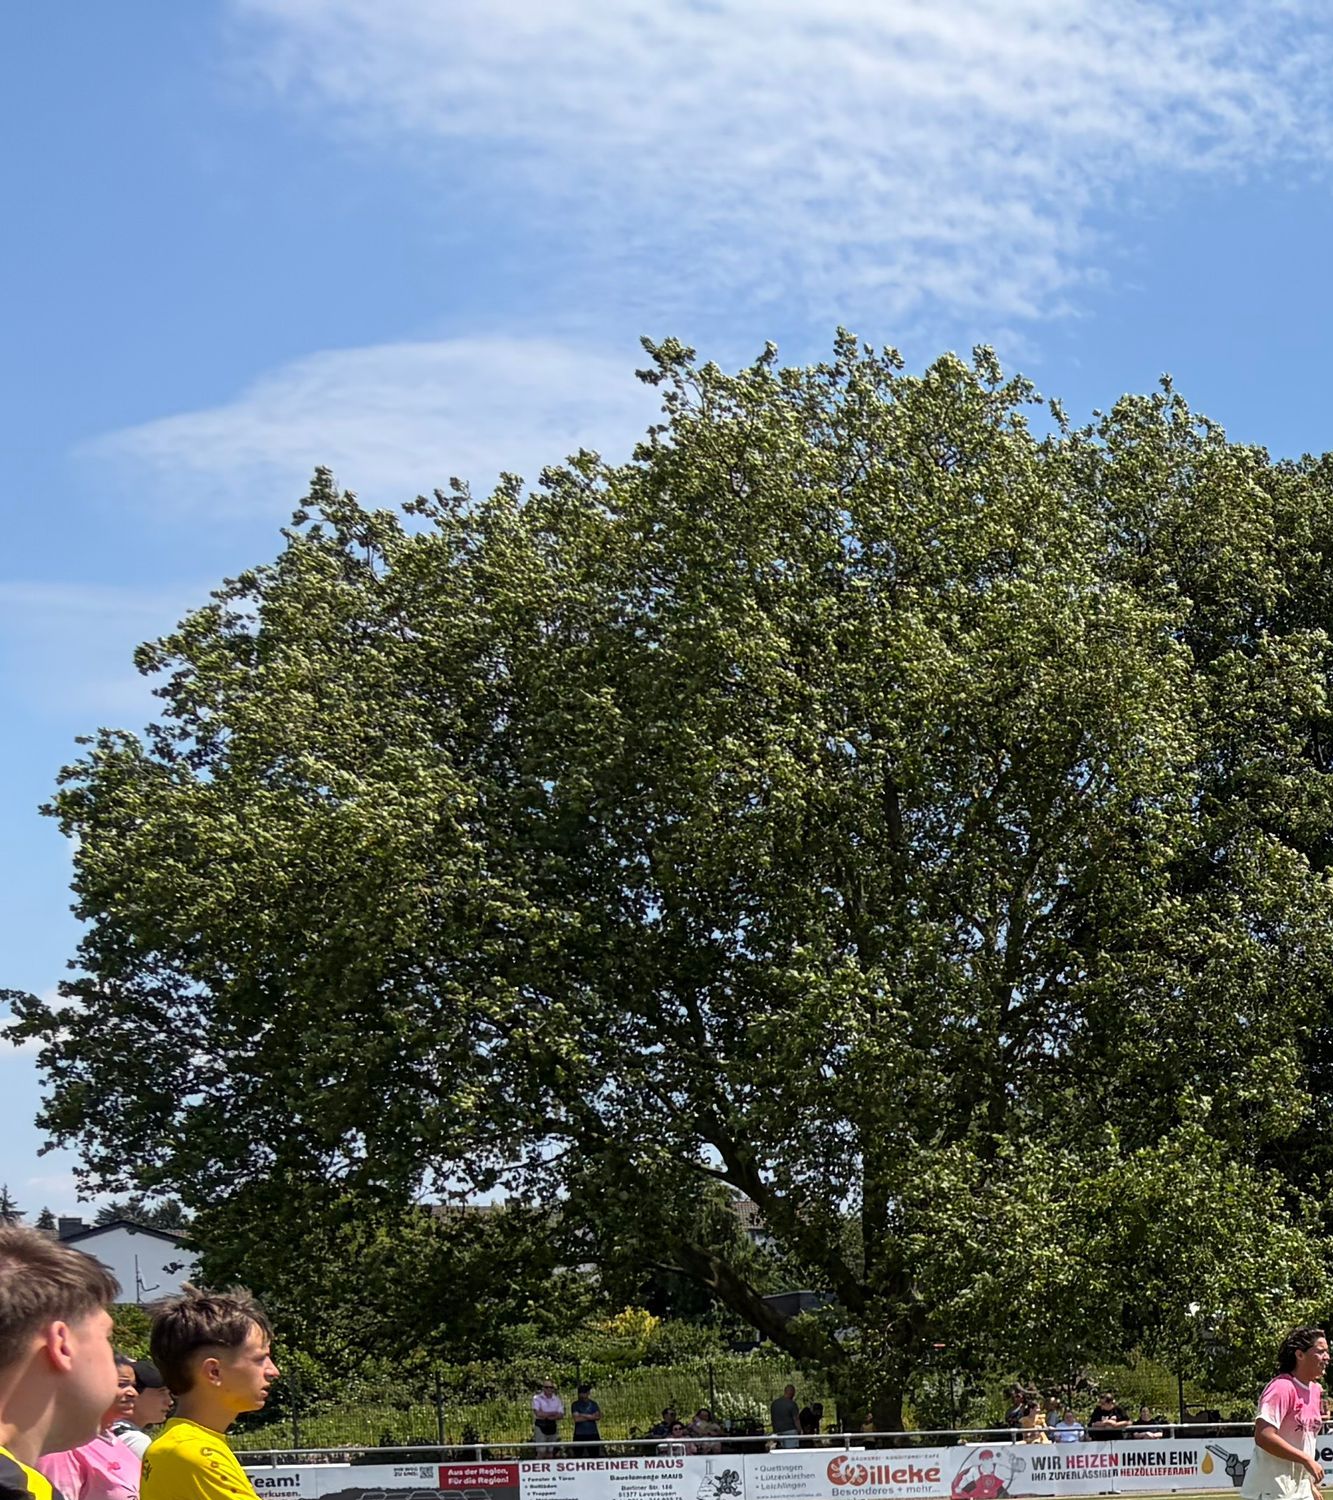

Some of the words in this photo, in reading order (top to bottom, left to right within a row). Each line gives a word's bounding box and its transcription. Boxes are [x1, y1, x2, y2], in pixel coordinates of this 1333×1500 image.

[522, 1463, 551, 1473] DER
[556, 1460, 639, 1472] SCHREINER
[644, 1459, 684, 1470] MAUS
[1031, 1456, 1062, 1471] WIR
[1066, 1453, 1119, 1469] HEIZEN
[1122, 1452, 1166, 1466] IHNEN
[1170, 1451, 1198, 1465] EIN!
[448, 1468, 463, 1476] Aus
[479, 1467, 508, 1477] Region,
[1032, 1473, 1046, 1481] IHR
[1049, 1469, 1119, 1480] ZUVERLÄSSIGER
[1120, 1466, 1198, 1477] HEIZÖLLIEFERANT!
[448, 1477, 462, 1485] Für
[463, 1476, 476, 1484] die
[478, 1476, 508, 1485] Region!
[832, 1486, 894, 1497] Besonderes
